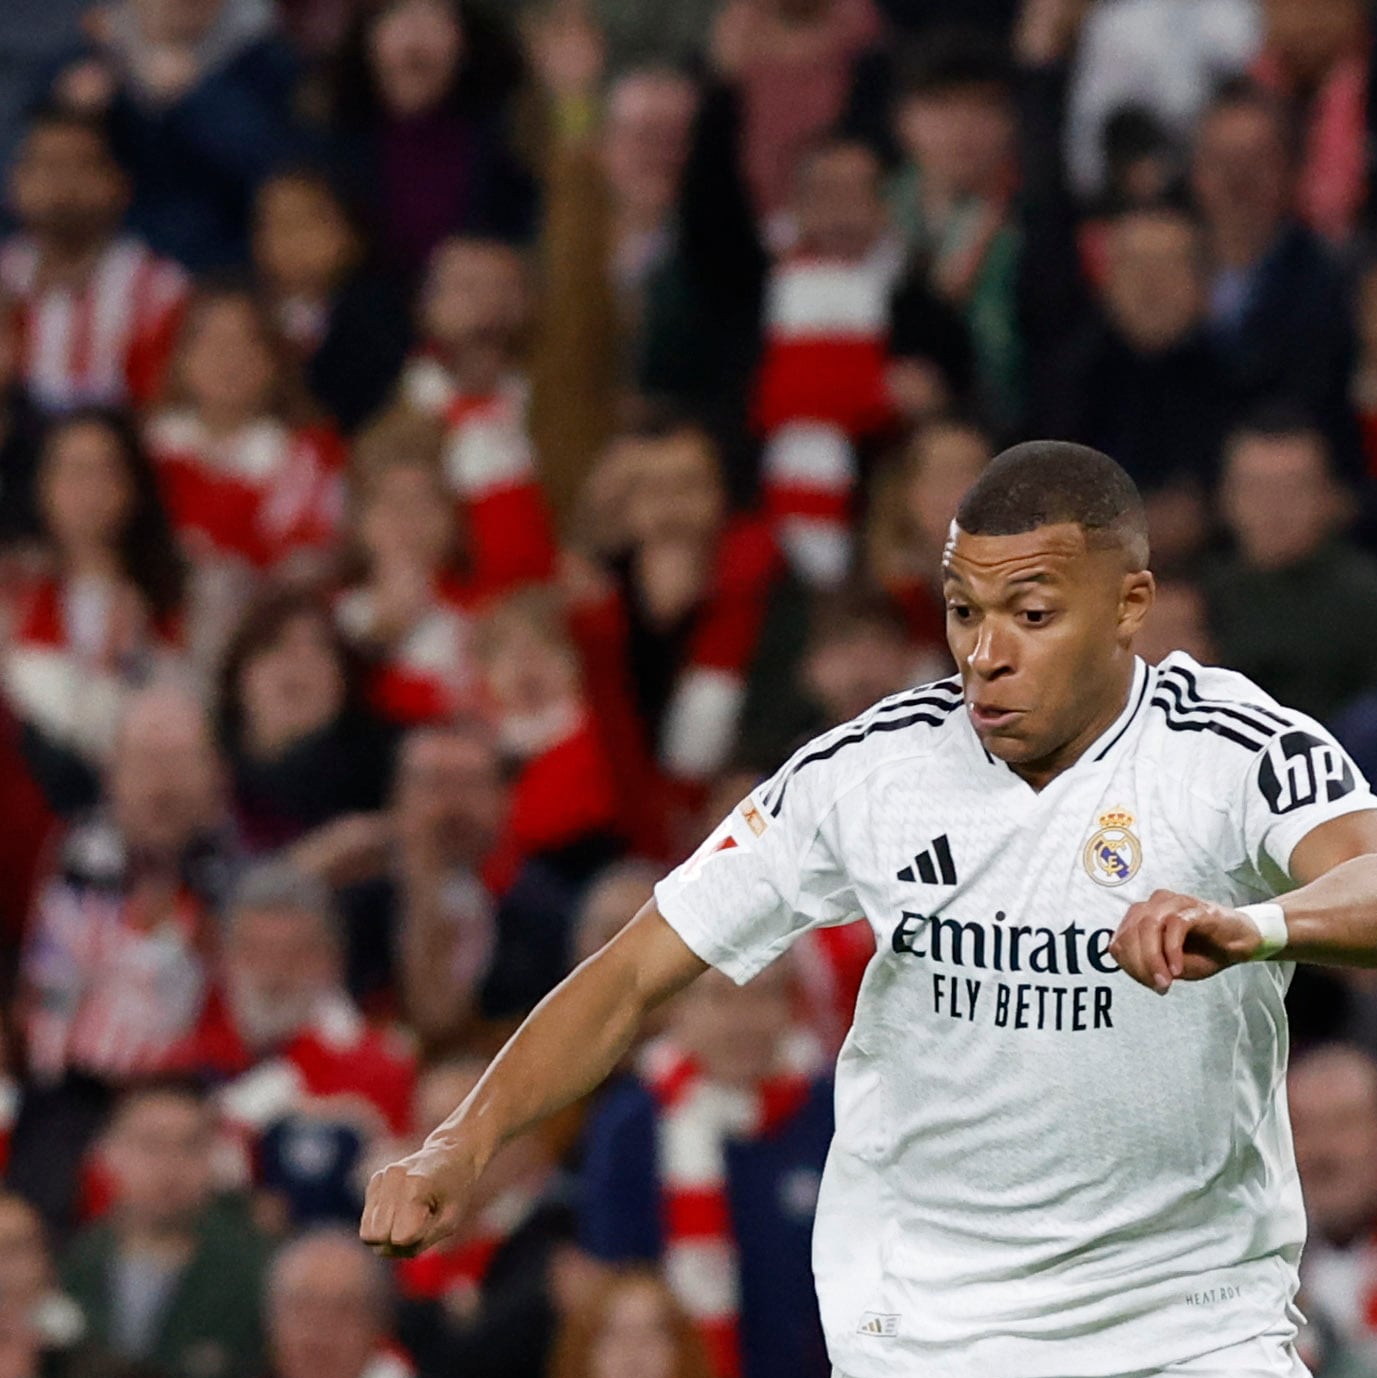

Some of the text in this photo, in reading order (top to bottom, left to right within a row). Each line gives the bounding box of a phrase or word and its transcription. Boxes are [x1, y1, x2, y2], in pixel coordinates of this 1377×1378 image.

[1263, 732, 1348, 813] hp
[892, 911, 1123, 974] Emirate
[933, 974, 1114, 1031] FLY BETTER
